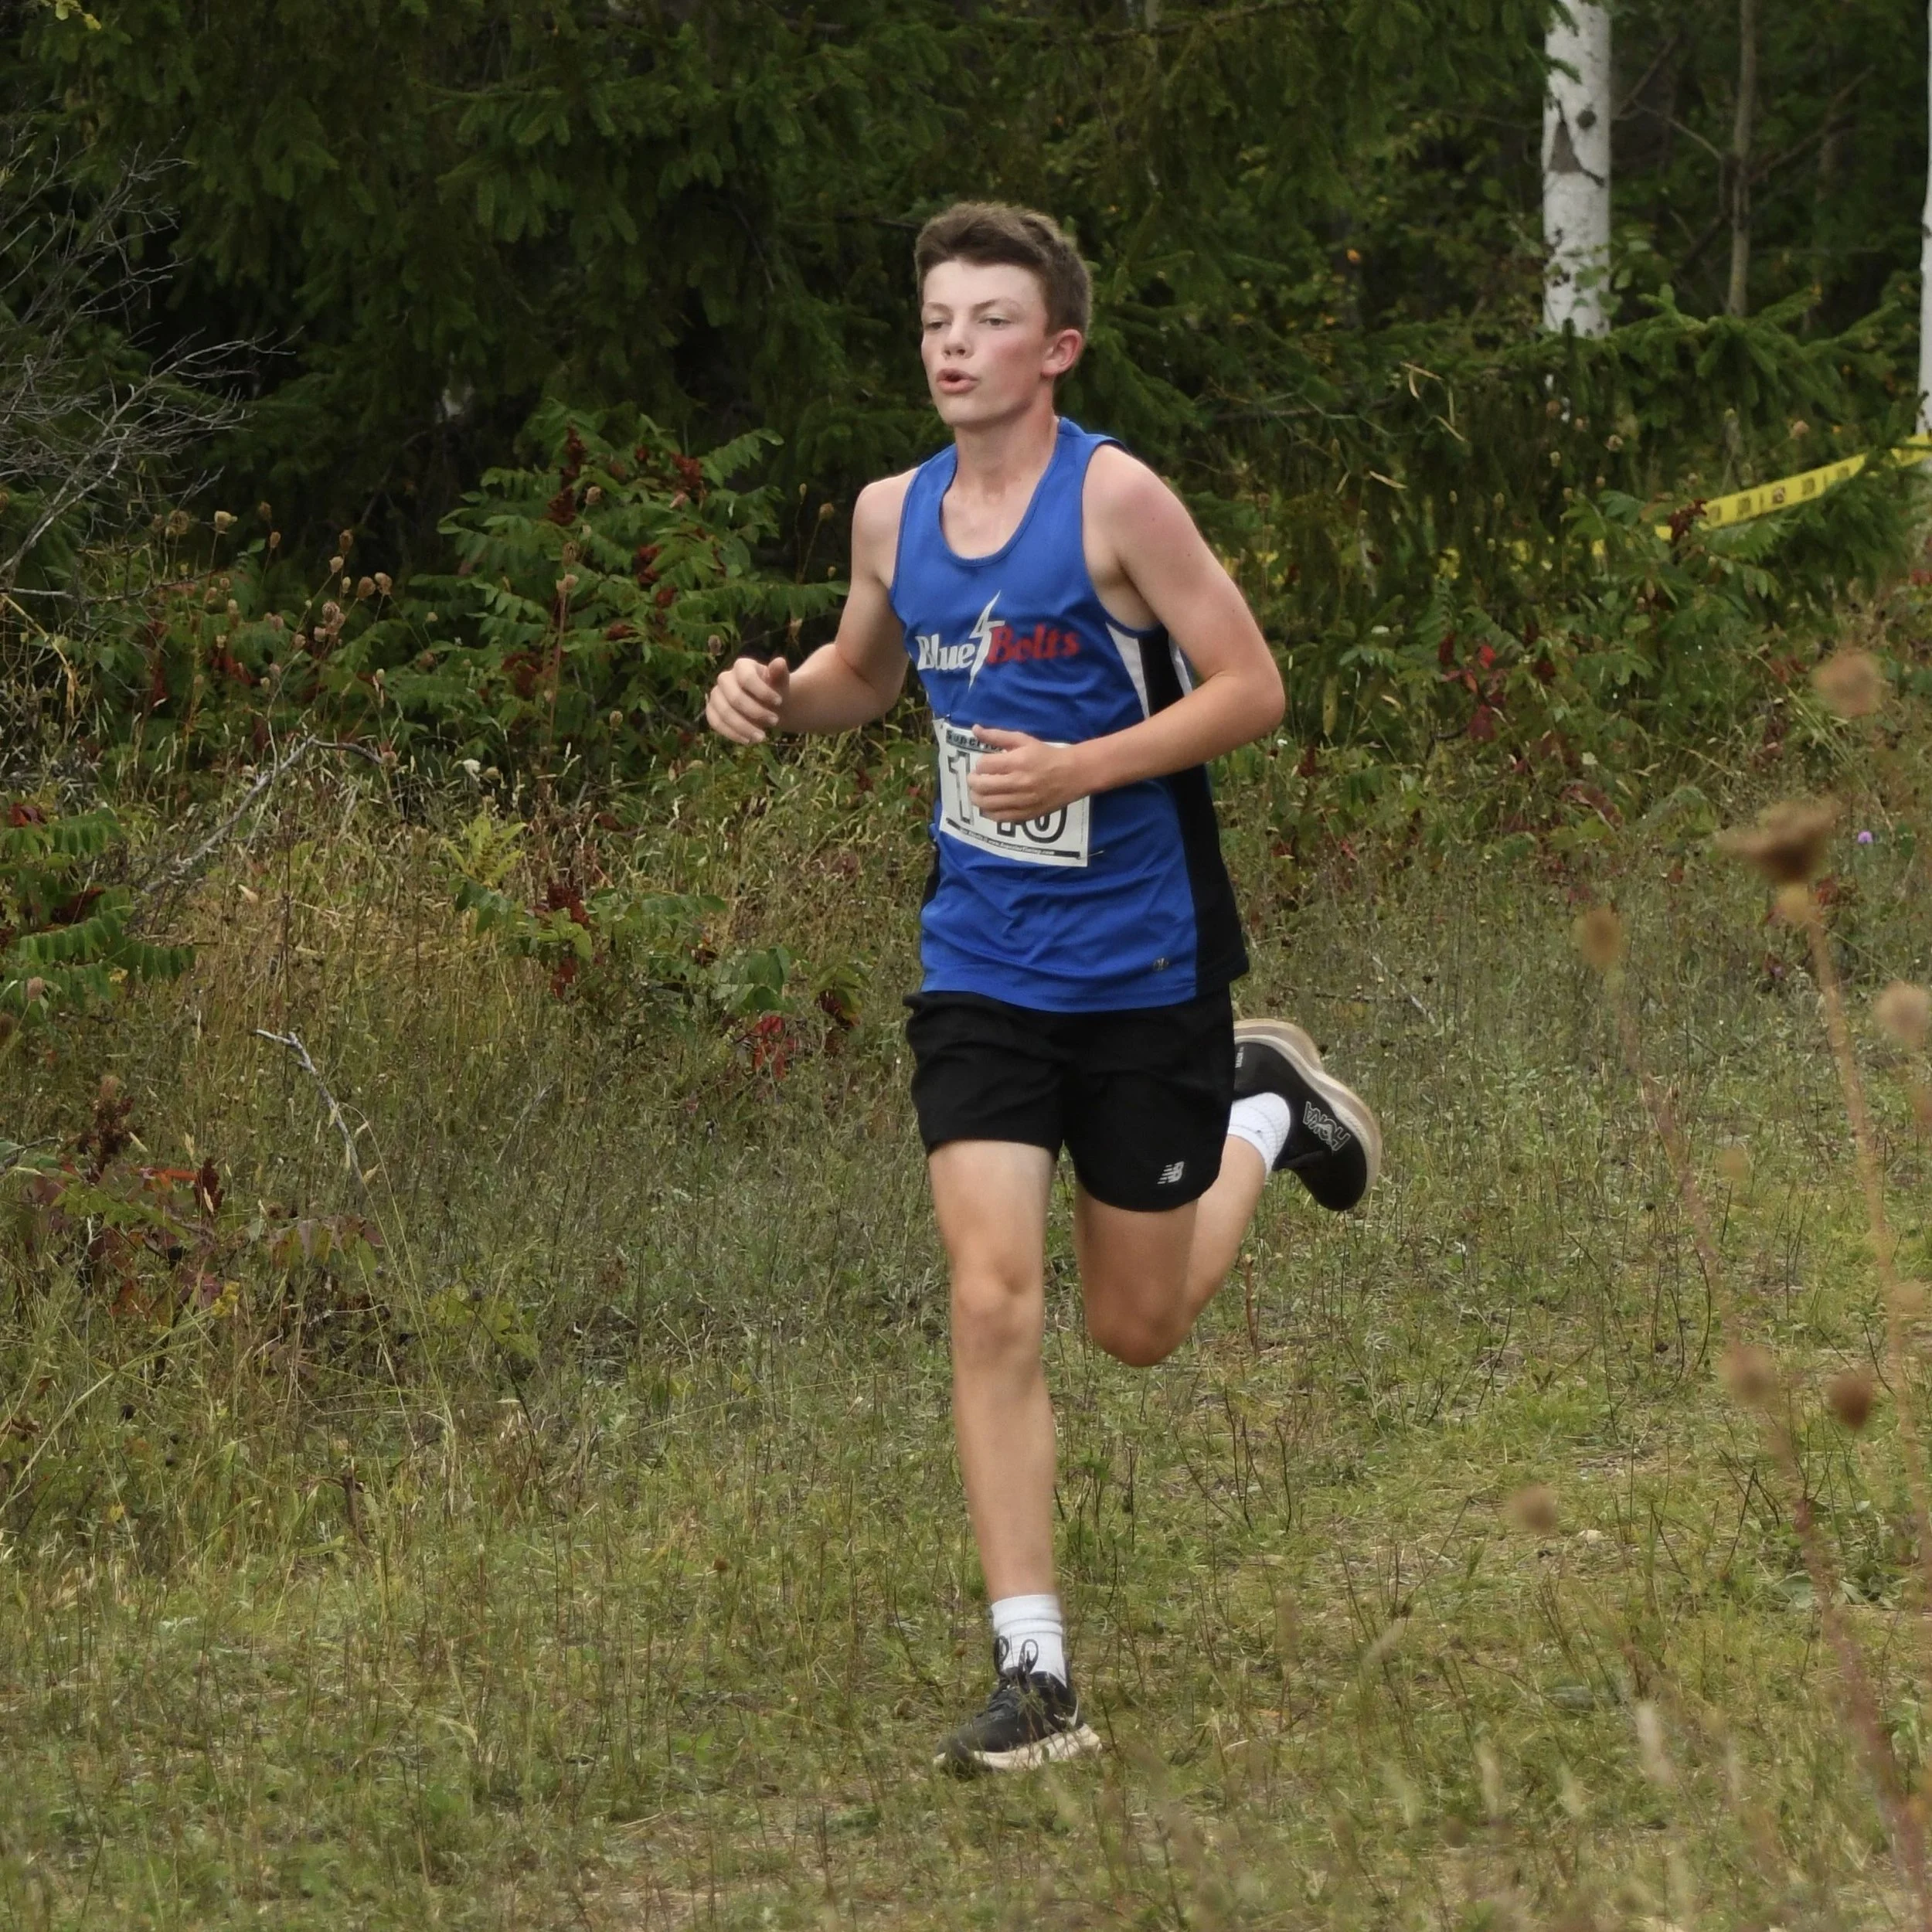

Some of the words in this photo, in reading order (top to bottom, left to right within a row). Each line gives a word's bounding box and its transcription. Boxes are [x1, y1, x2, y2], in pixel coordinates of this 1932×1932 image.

[915, 633, 975, 671] Blue
[985, 622, 1080, 665] Bolts
[1302, 1100, 1351, 1151] HOKA
